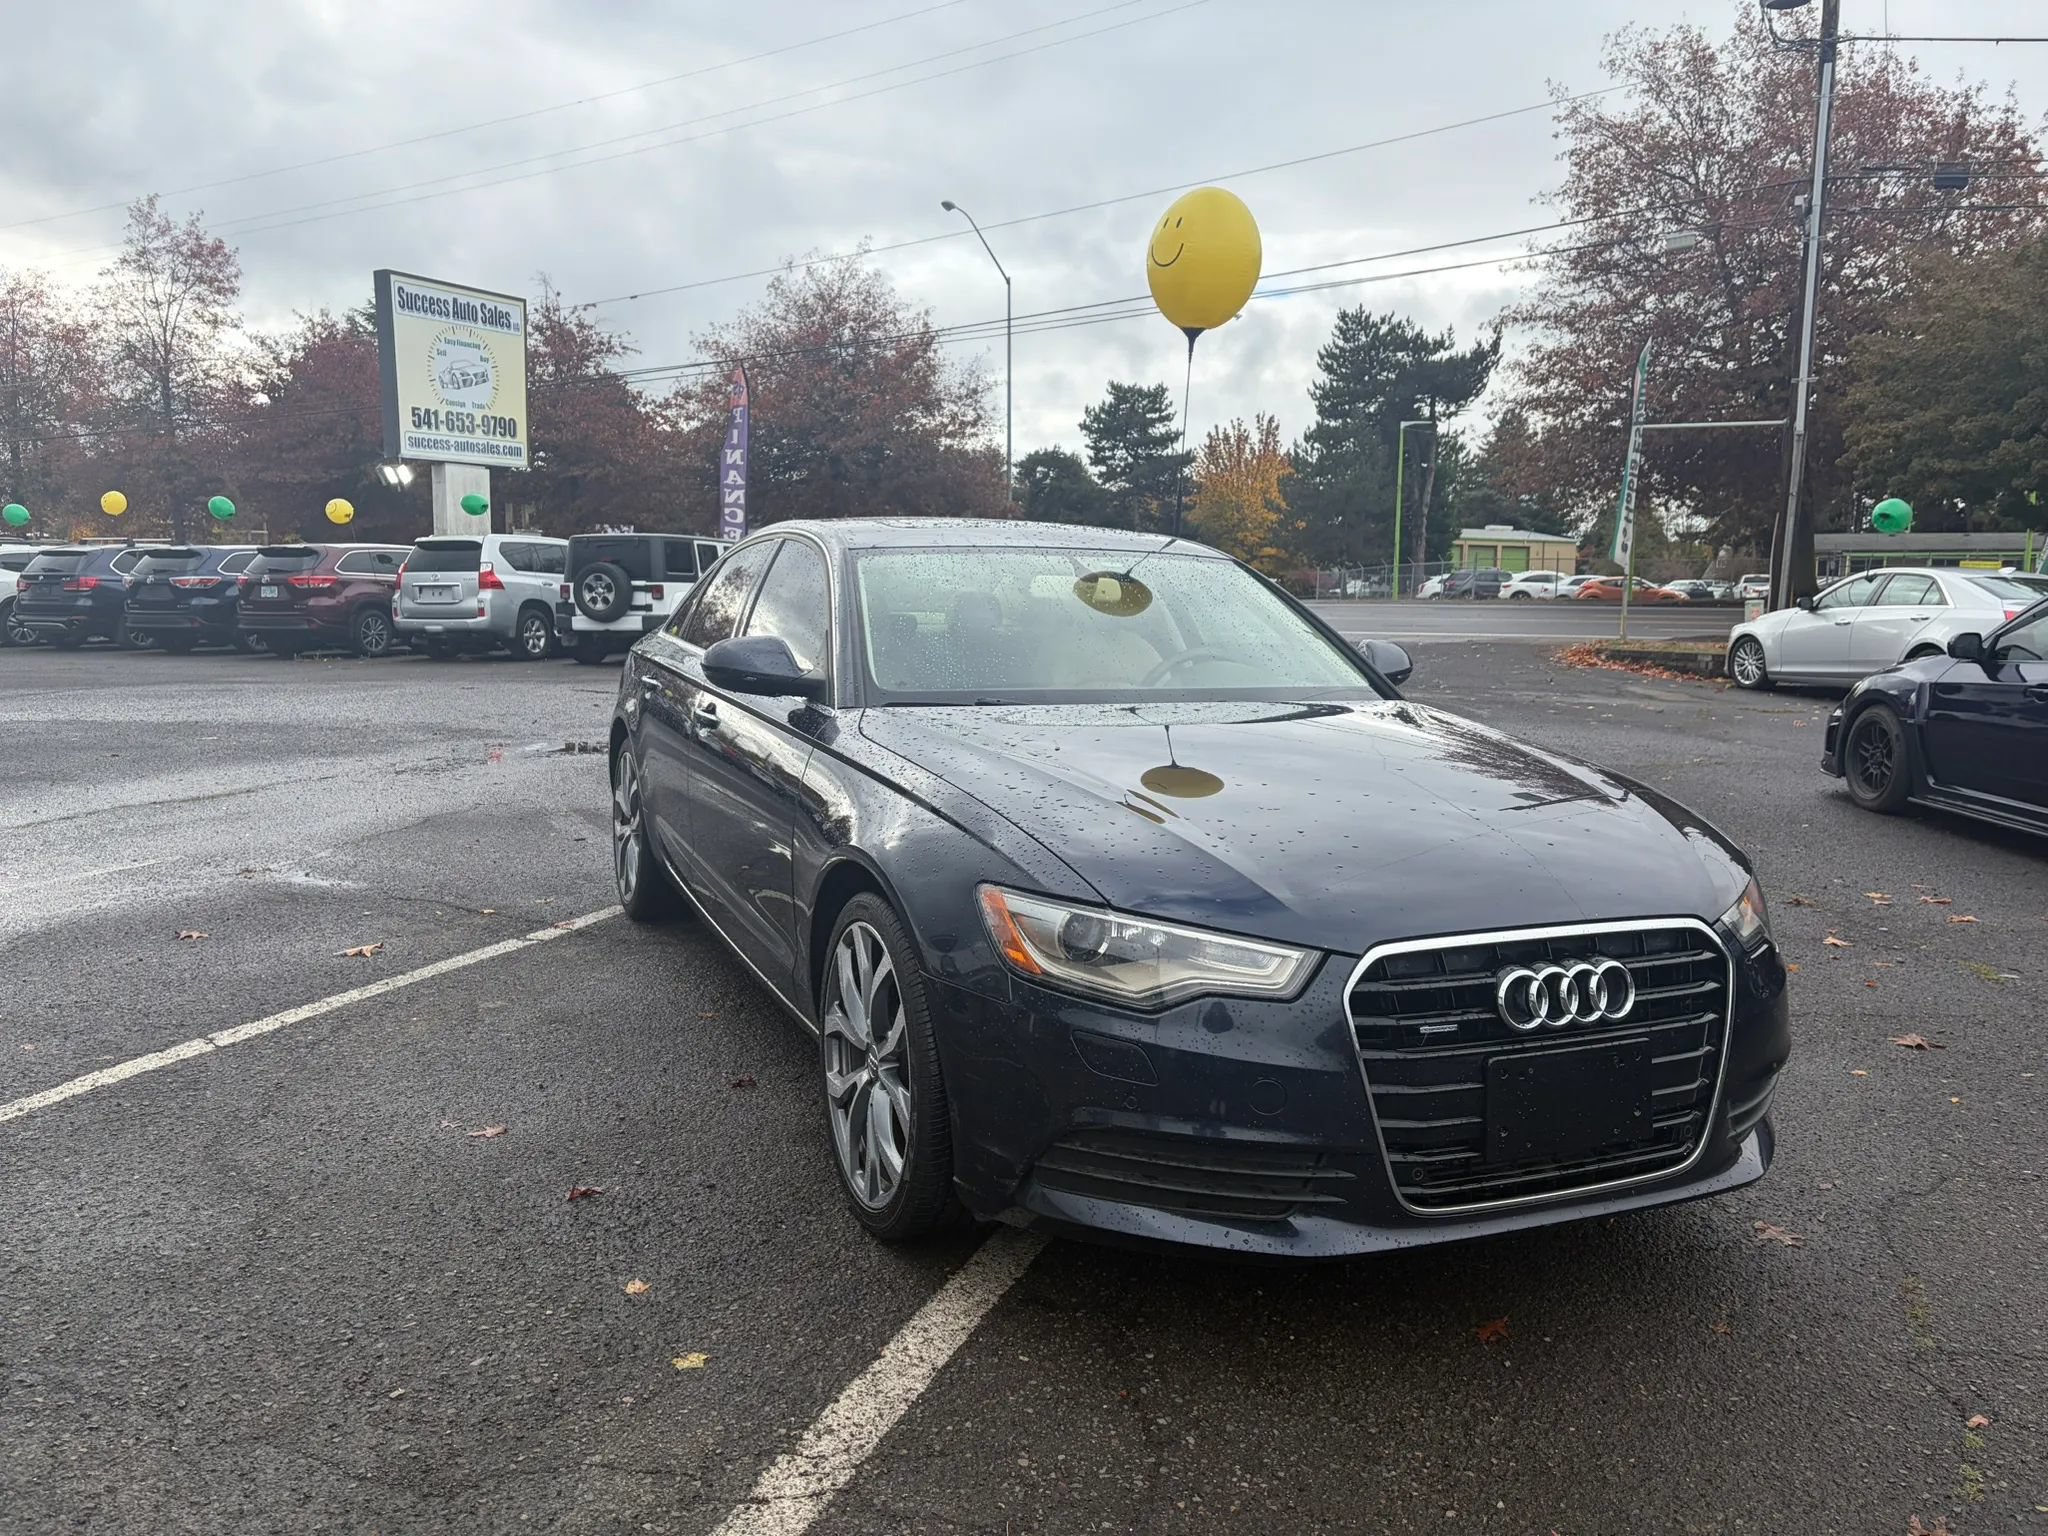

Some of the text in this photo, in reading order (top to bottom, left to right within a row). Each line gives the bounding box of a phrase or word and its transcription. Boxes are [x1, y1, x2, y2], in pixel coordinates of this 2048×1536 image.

[397, 286, 451, 318] Success
[452, 297, 478, 323] Auto
[480, 302, 511, 330] Sales
[412, 406, 517, 438] 541-653-9790
[408, 436, 522, 457] success-autosales.com
